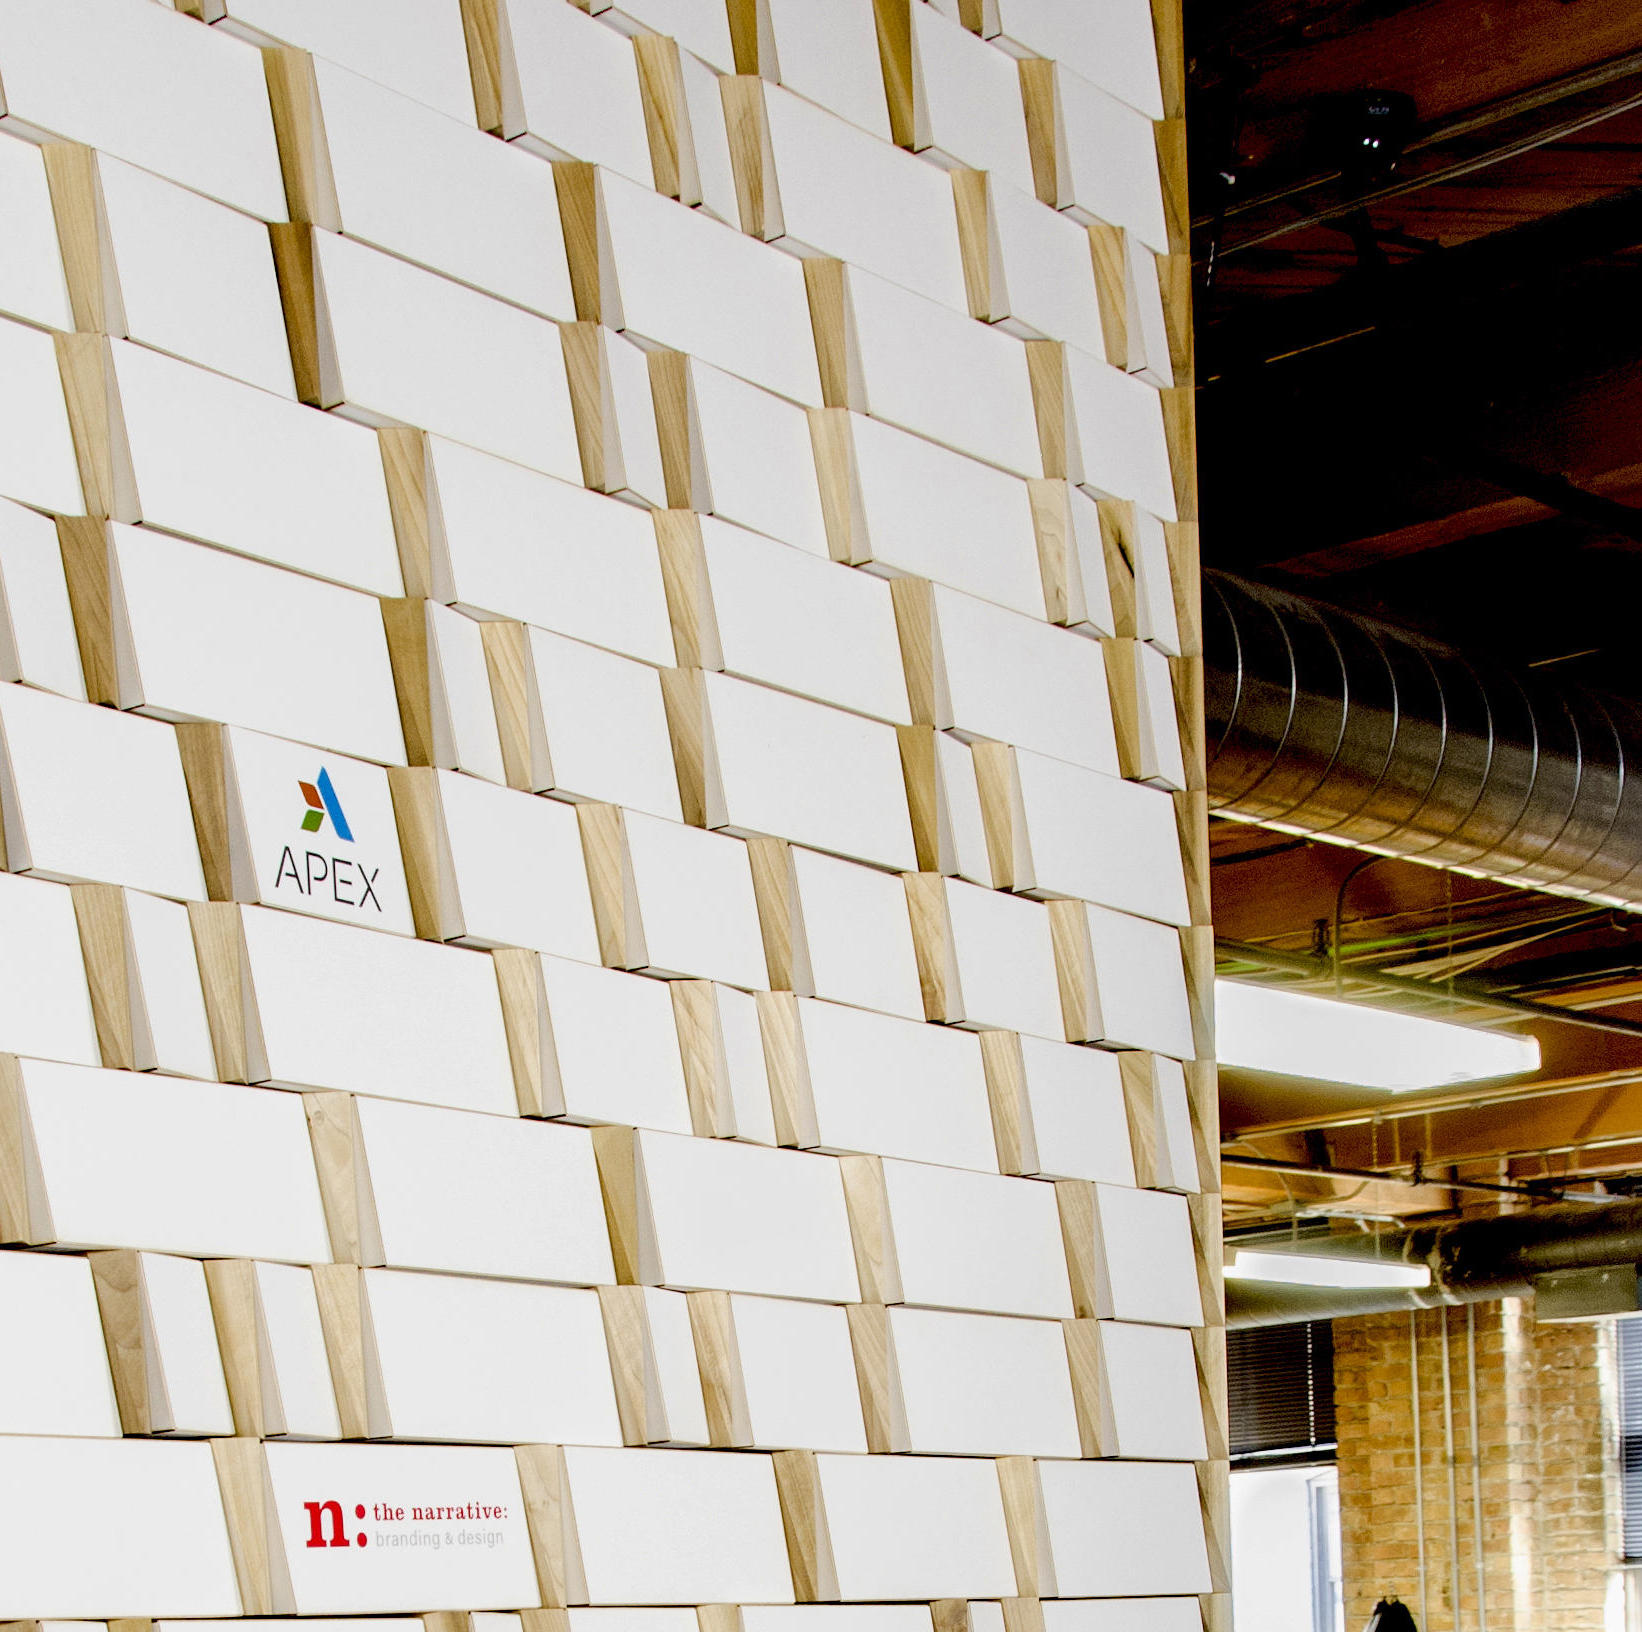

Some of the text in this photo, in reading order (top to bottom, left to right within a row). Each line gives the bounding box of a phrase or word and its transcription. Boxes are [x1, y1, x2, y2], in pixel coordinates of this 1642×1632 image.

[274, 845, 383, 913] APEX
[372, 1501, 508, 1522] the narrative:
[375, 1529, 504, 1550] branding & design
